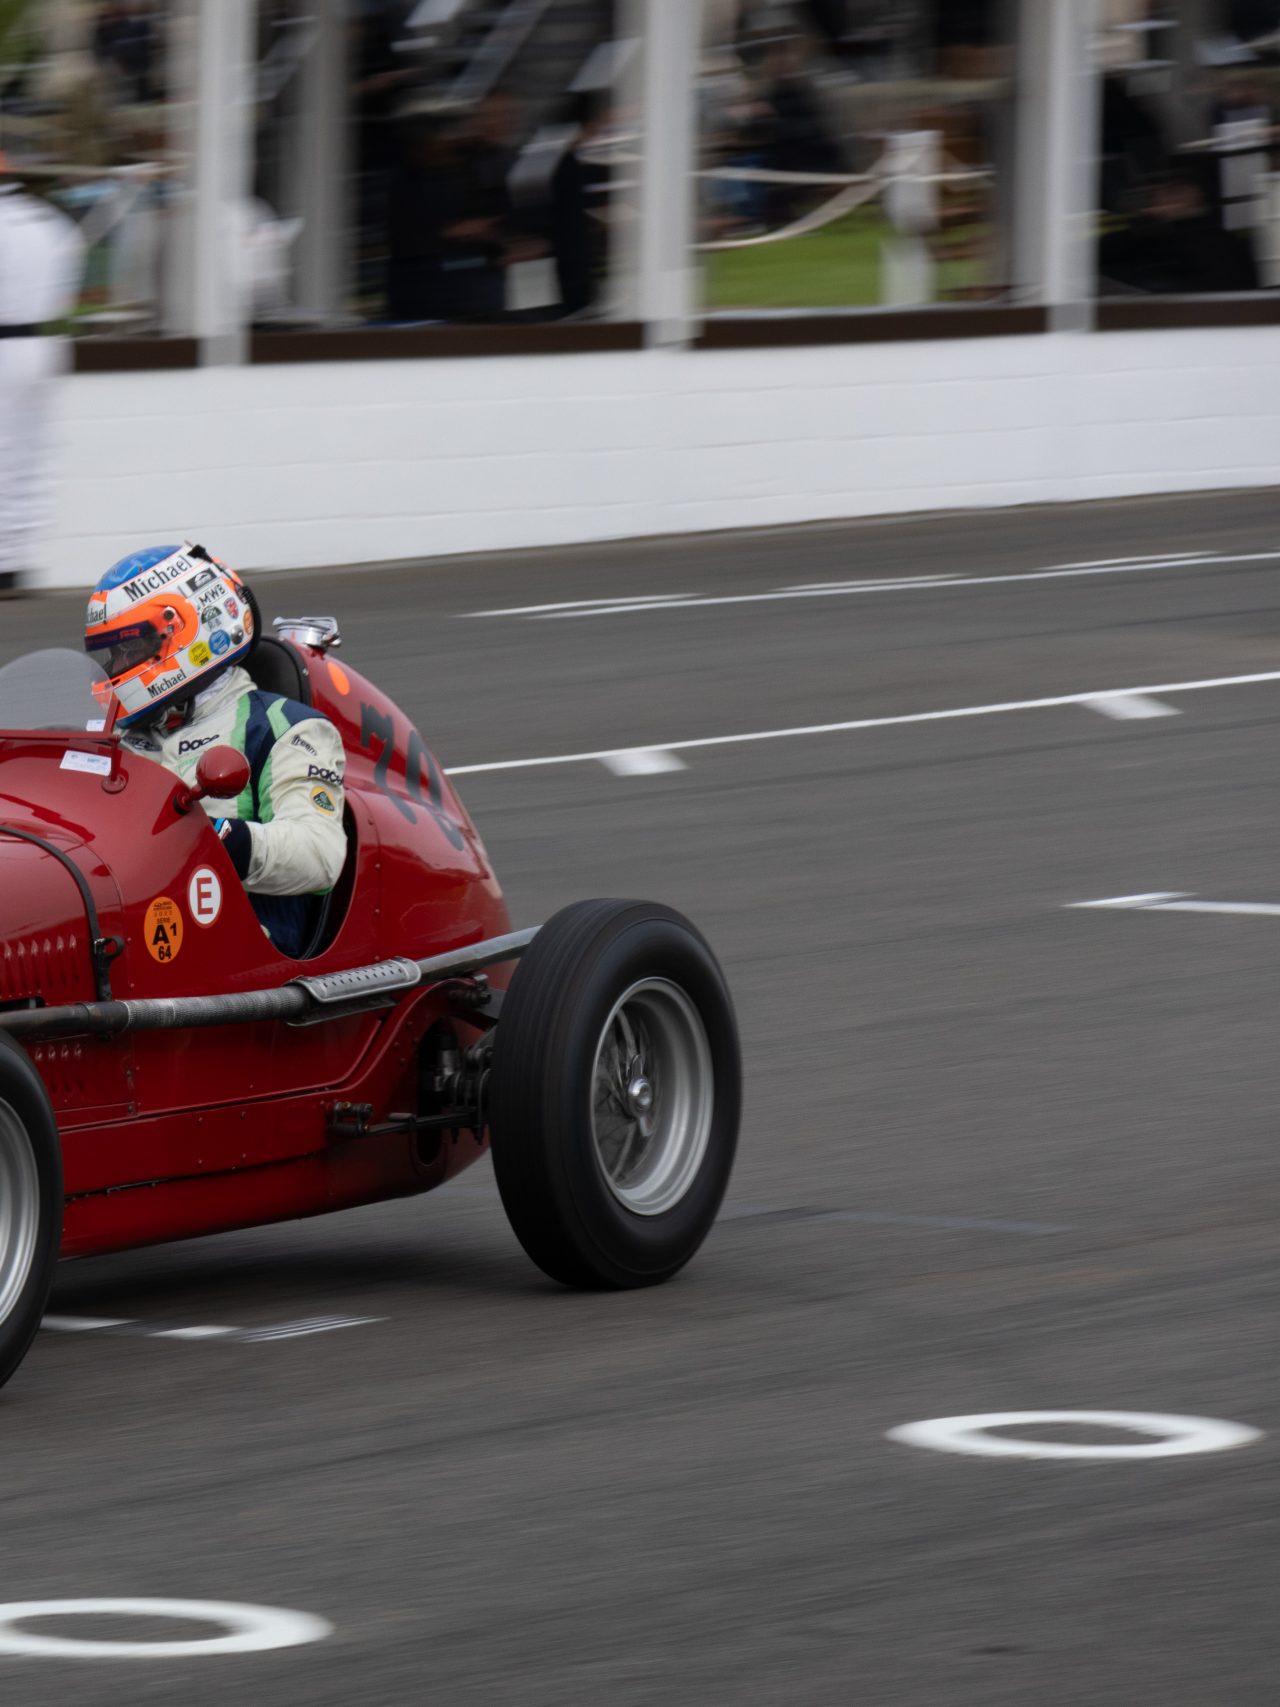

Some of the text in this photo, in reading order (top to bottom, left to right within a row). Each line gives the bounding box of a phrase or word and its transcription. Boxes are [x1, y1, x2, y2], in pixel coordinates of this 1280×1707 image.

[123, 555, 192, 602] Michael
[198, 584, 226, 606] MWB
[147, 669, 187, 698] Michael
[196, 877, 213, 915] E
[158, 945, 172, 960] 64
